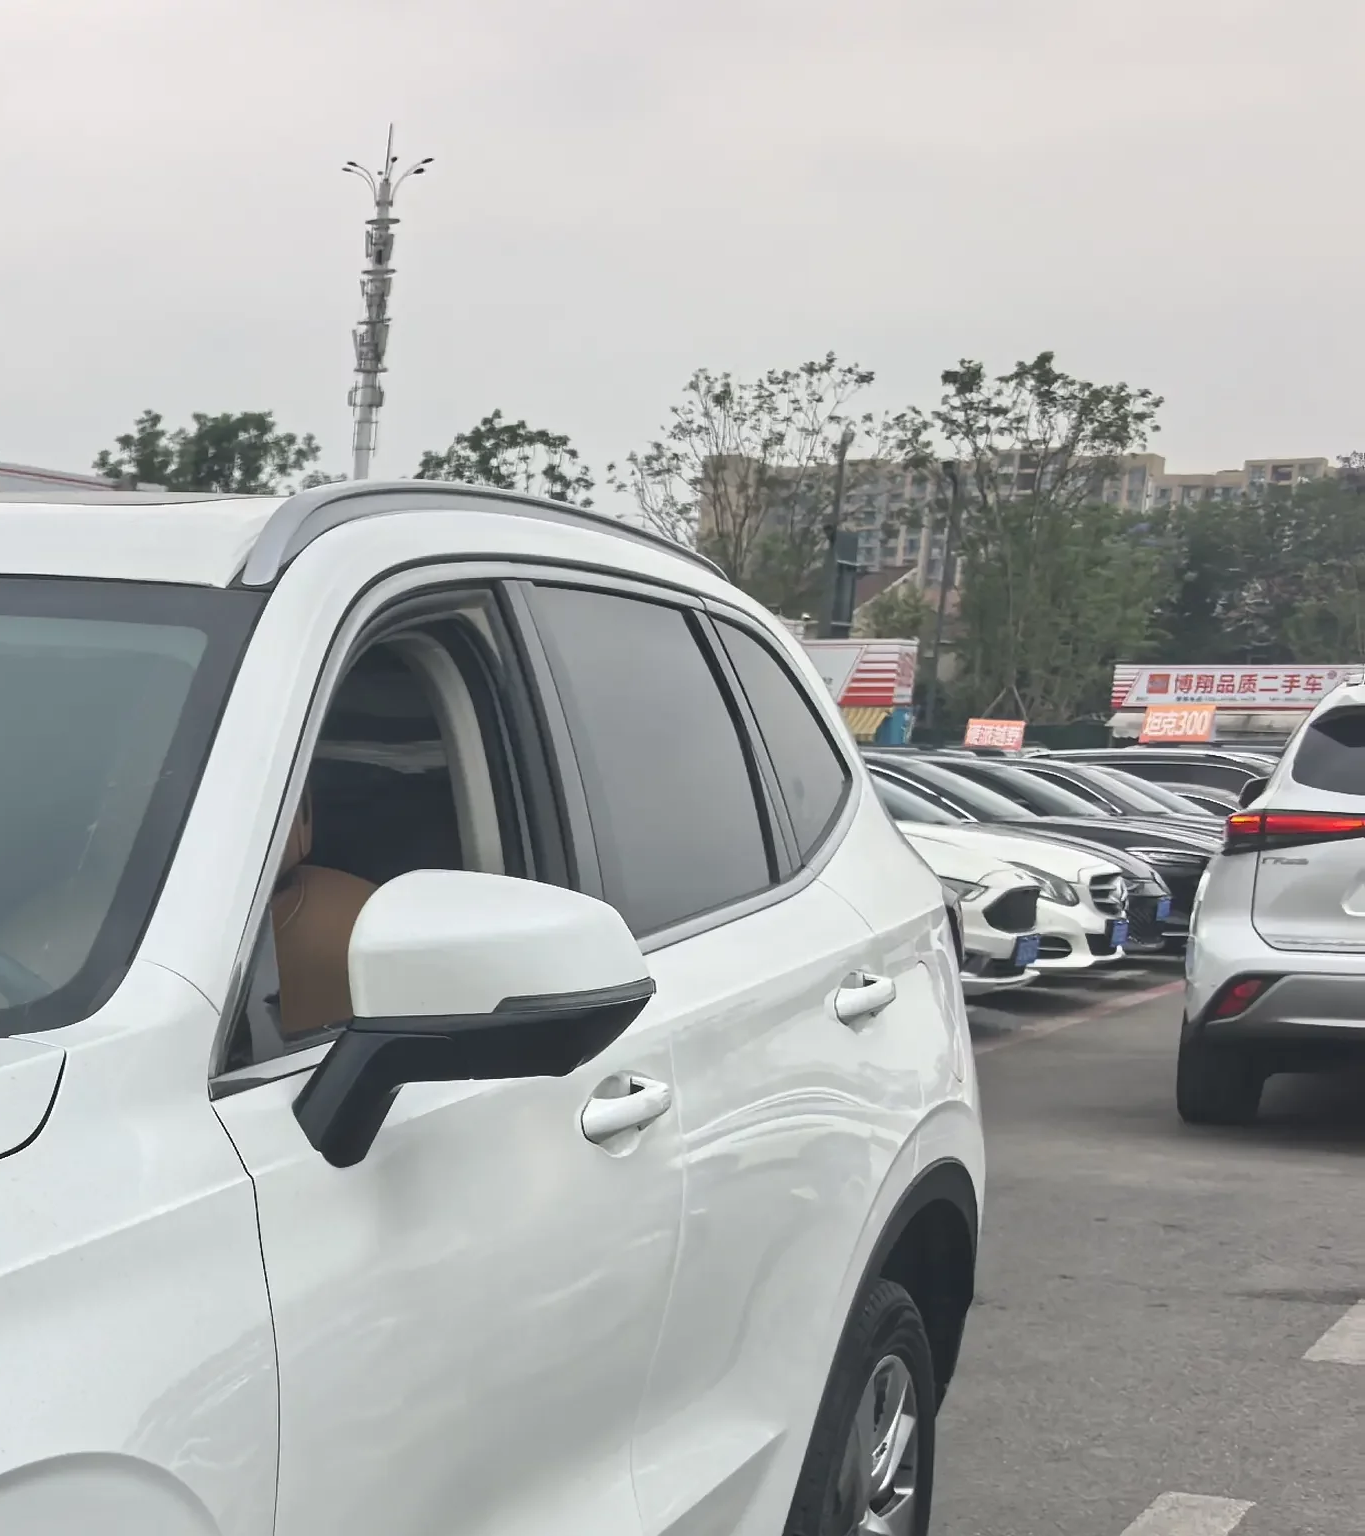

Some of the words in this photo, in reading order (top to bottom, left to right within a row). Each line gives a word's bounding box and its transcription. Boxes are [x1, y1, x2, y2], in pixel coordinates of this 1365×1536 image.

[1174, 673, 1324, 694] 博翔品质二手车
[1143, 709, 1210, 737] 坦克300
